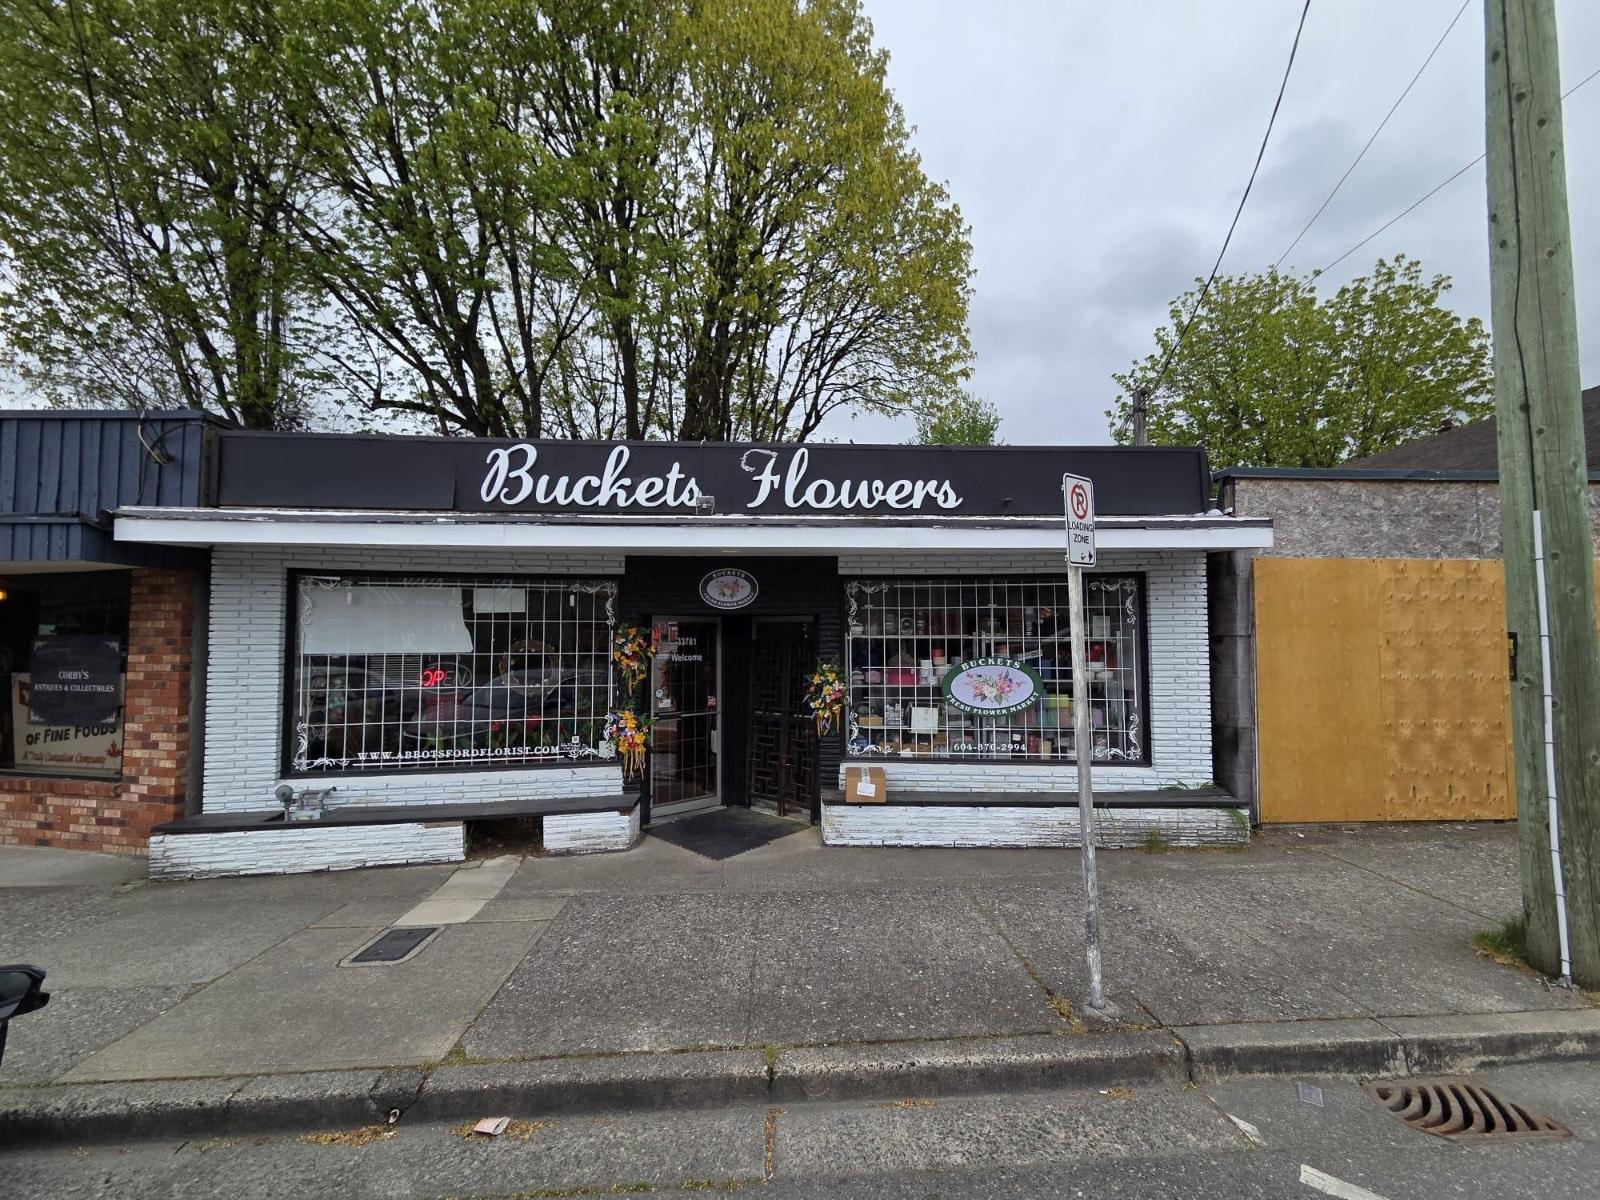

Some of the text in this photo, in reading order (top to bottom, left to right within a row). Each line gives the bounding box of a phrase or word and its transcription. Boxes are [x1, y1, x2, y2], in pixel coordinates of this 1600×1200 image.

[480, 443, 963, 510] Buckets Flowers
[1068, 521, 1094, 532] LOADING
[1073, 534, 1090, 544] ZONE
[671, 653, 703, 662] Welcome
[961, 657, 1021, 671] BUCKETS
[58, 670, 90, 680] CORBY'S
[946, 691, 1039, 715] FRESH FLOWER MARKET
[26, 725, 117, 746] OF FINE FOODS
